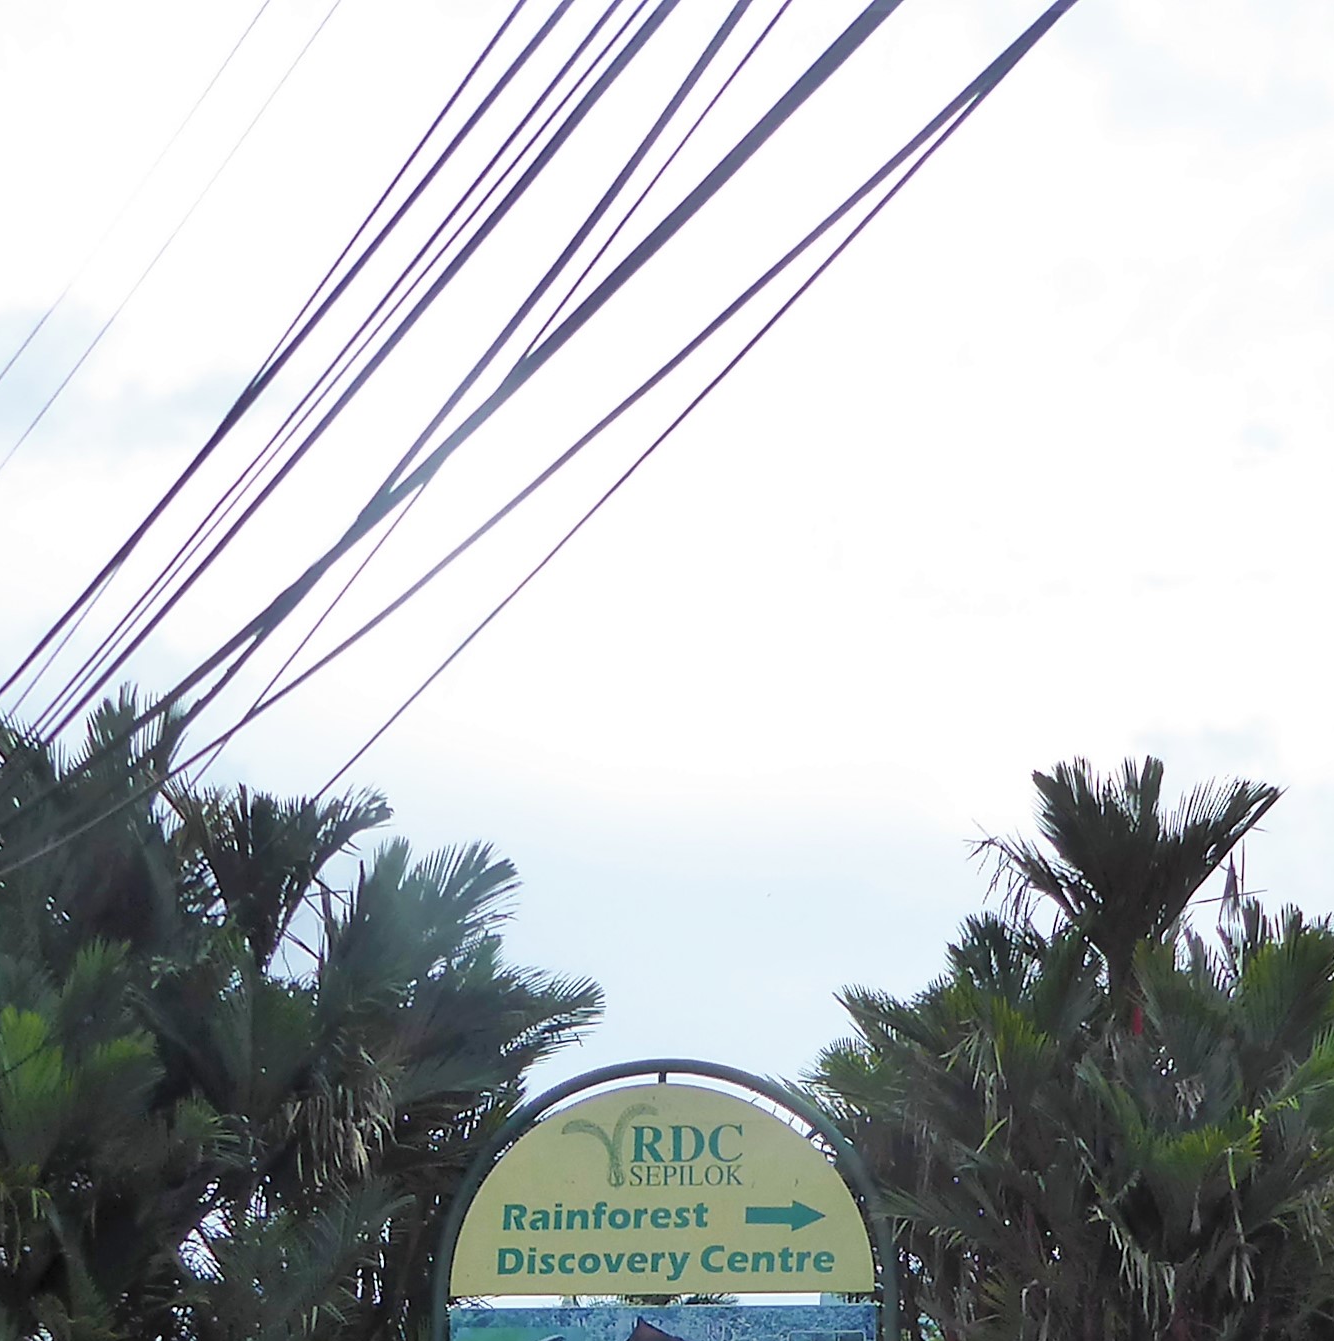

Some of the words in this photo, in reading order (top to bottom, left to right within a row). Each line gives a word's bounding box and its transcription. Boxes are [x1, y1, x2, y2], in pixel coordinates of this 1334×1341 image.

[632, 1124, 743, 1164] RDC
[629, 1164, 743, 1187] SEPILOK
[502, 1202, 709, 1231] Rainforest
[497, 1247, 690, 1280] Discovery
[700, 1245, 835, 1273] Centre
